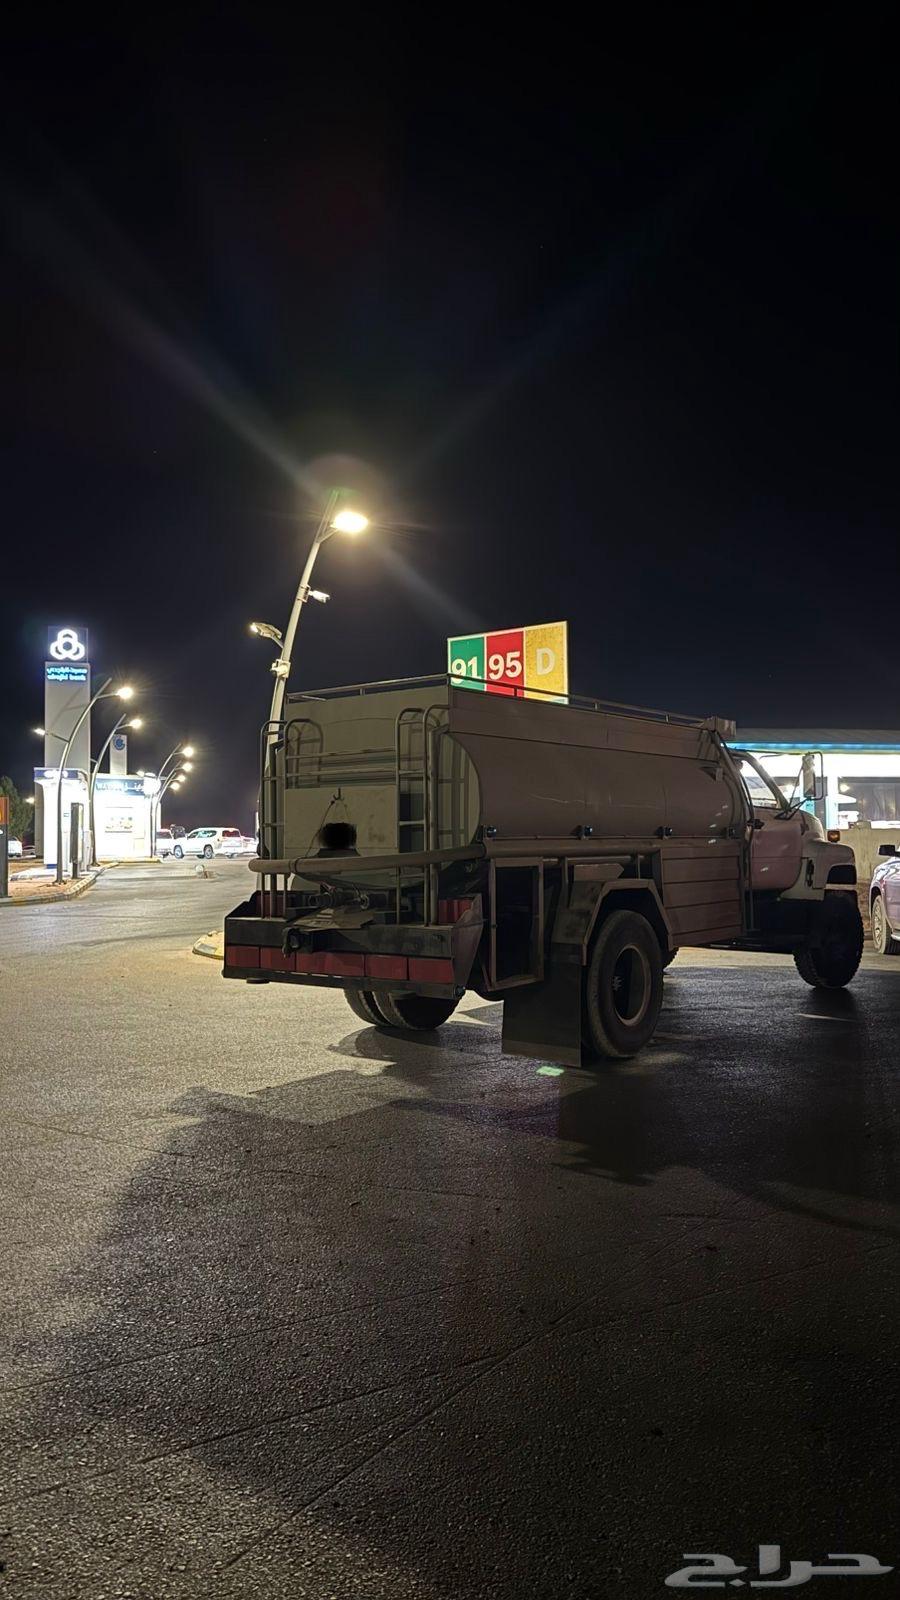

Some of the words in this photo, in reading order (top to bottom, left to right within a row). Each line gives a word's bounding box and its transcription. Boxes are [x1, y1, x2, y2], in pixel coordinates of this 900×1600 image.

[451, 656, 482, 684] 91
[488, 651, 523, 681] 95
[536, 647, 556, 676] D
